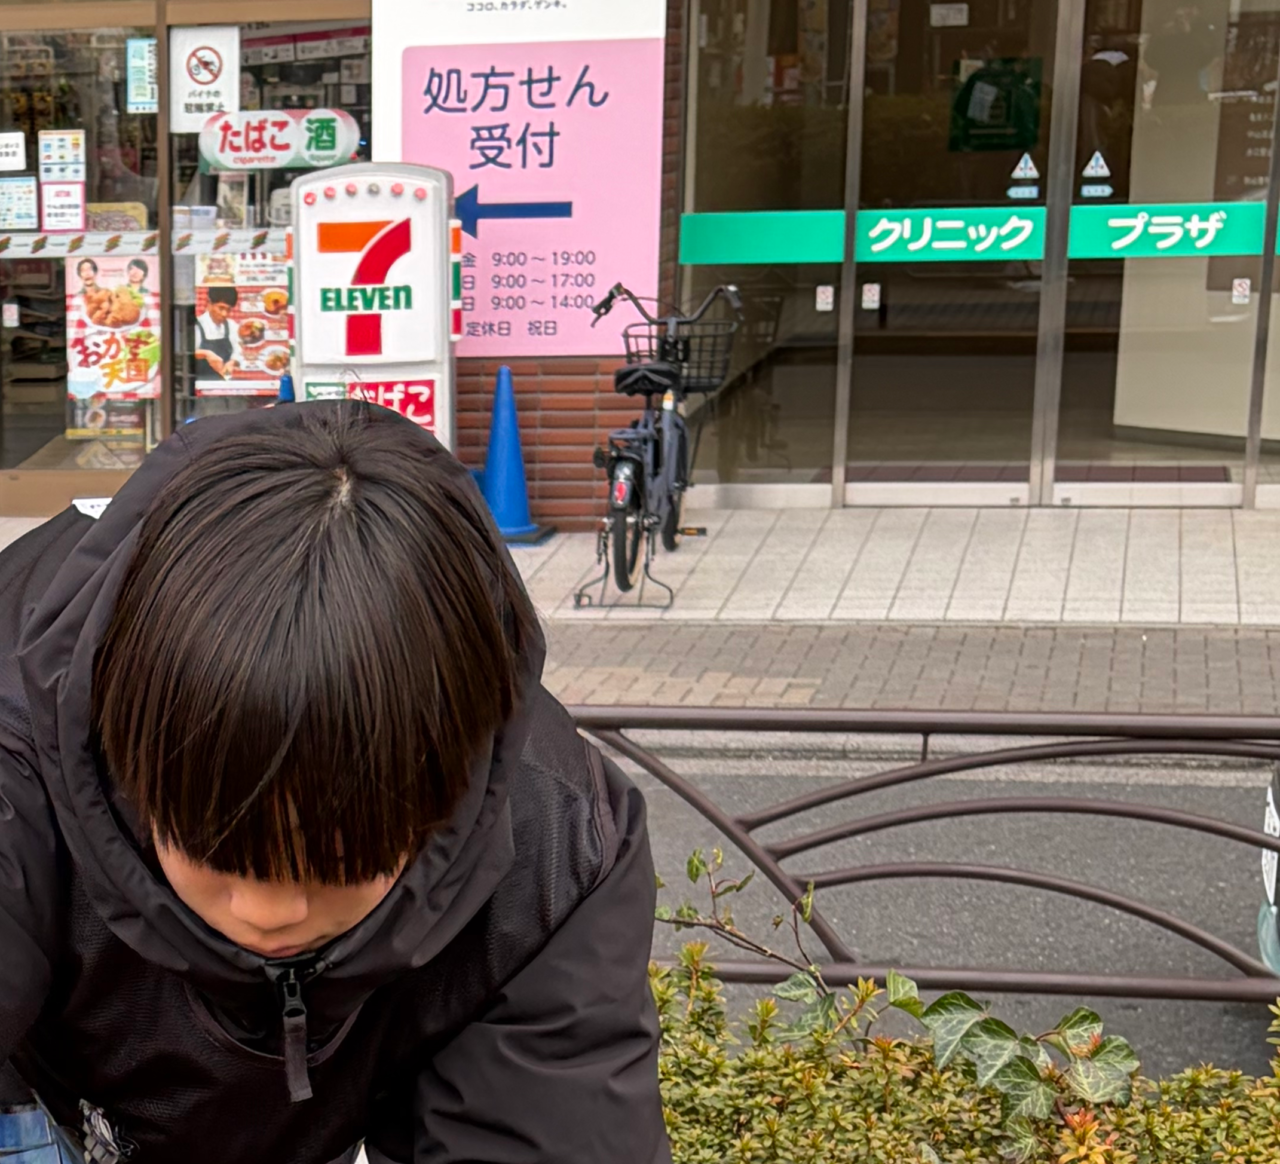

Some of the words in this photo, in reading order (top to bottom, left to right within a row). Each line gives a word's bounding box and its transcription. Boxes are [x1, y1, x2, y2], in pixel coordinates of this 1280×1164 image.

[423, 65, 609, 114] 処方せん
[219, 119, 291, 153] たばこ
[305, 117, 337, 151] 酒
[469, 121, 560, 169] 受付
[868, 215, 1033, 252] クリニック
[1107, 210, 1227, 249] プラザ
[317, 218, 411, 356] 7
[466, 321, 511, 336] 定休日
[528, 320, 557, 336] 祝日
